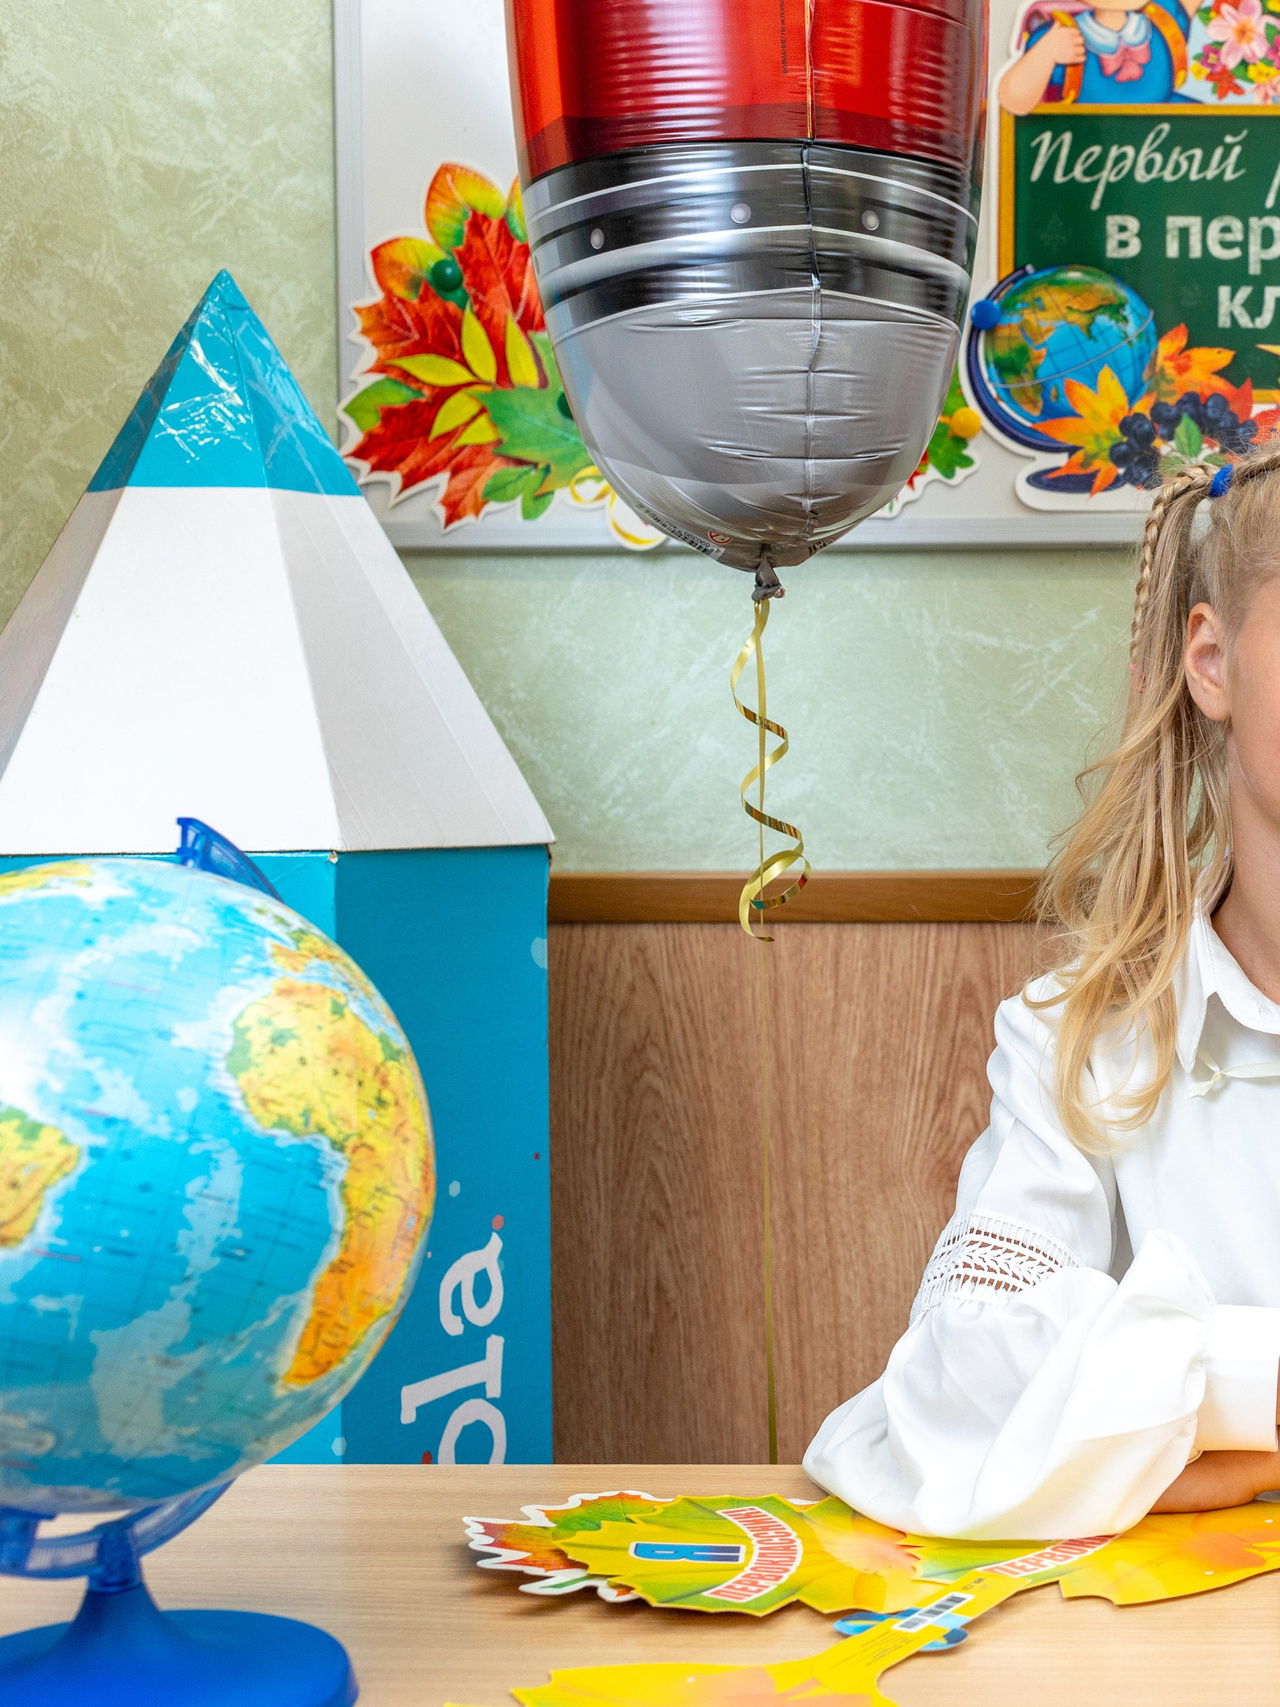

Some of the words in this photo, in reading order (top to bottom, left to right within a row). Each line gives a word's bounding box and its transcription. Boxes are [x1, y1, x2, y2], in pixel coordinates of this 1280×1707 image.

[1030, 122, 1249, 211] Первый
[1105, 214, 1142, 258] в
[634, 1542, 741, 1563] Я
[711, 1507, 799, 1601] ПЕРВОКЛАССНИК!
